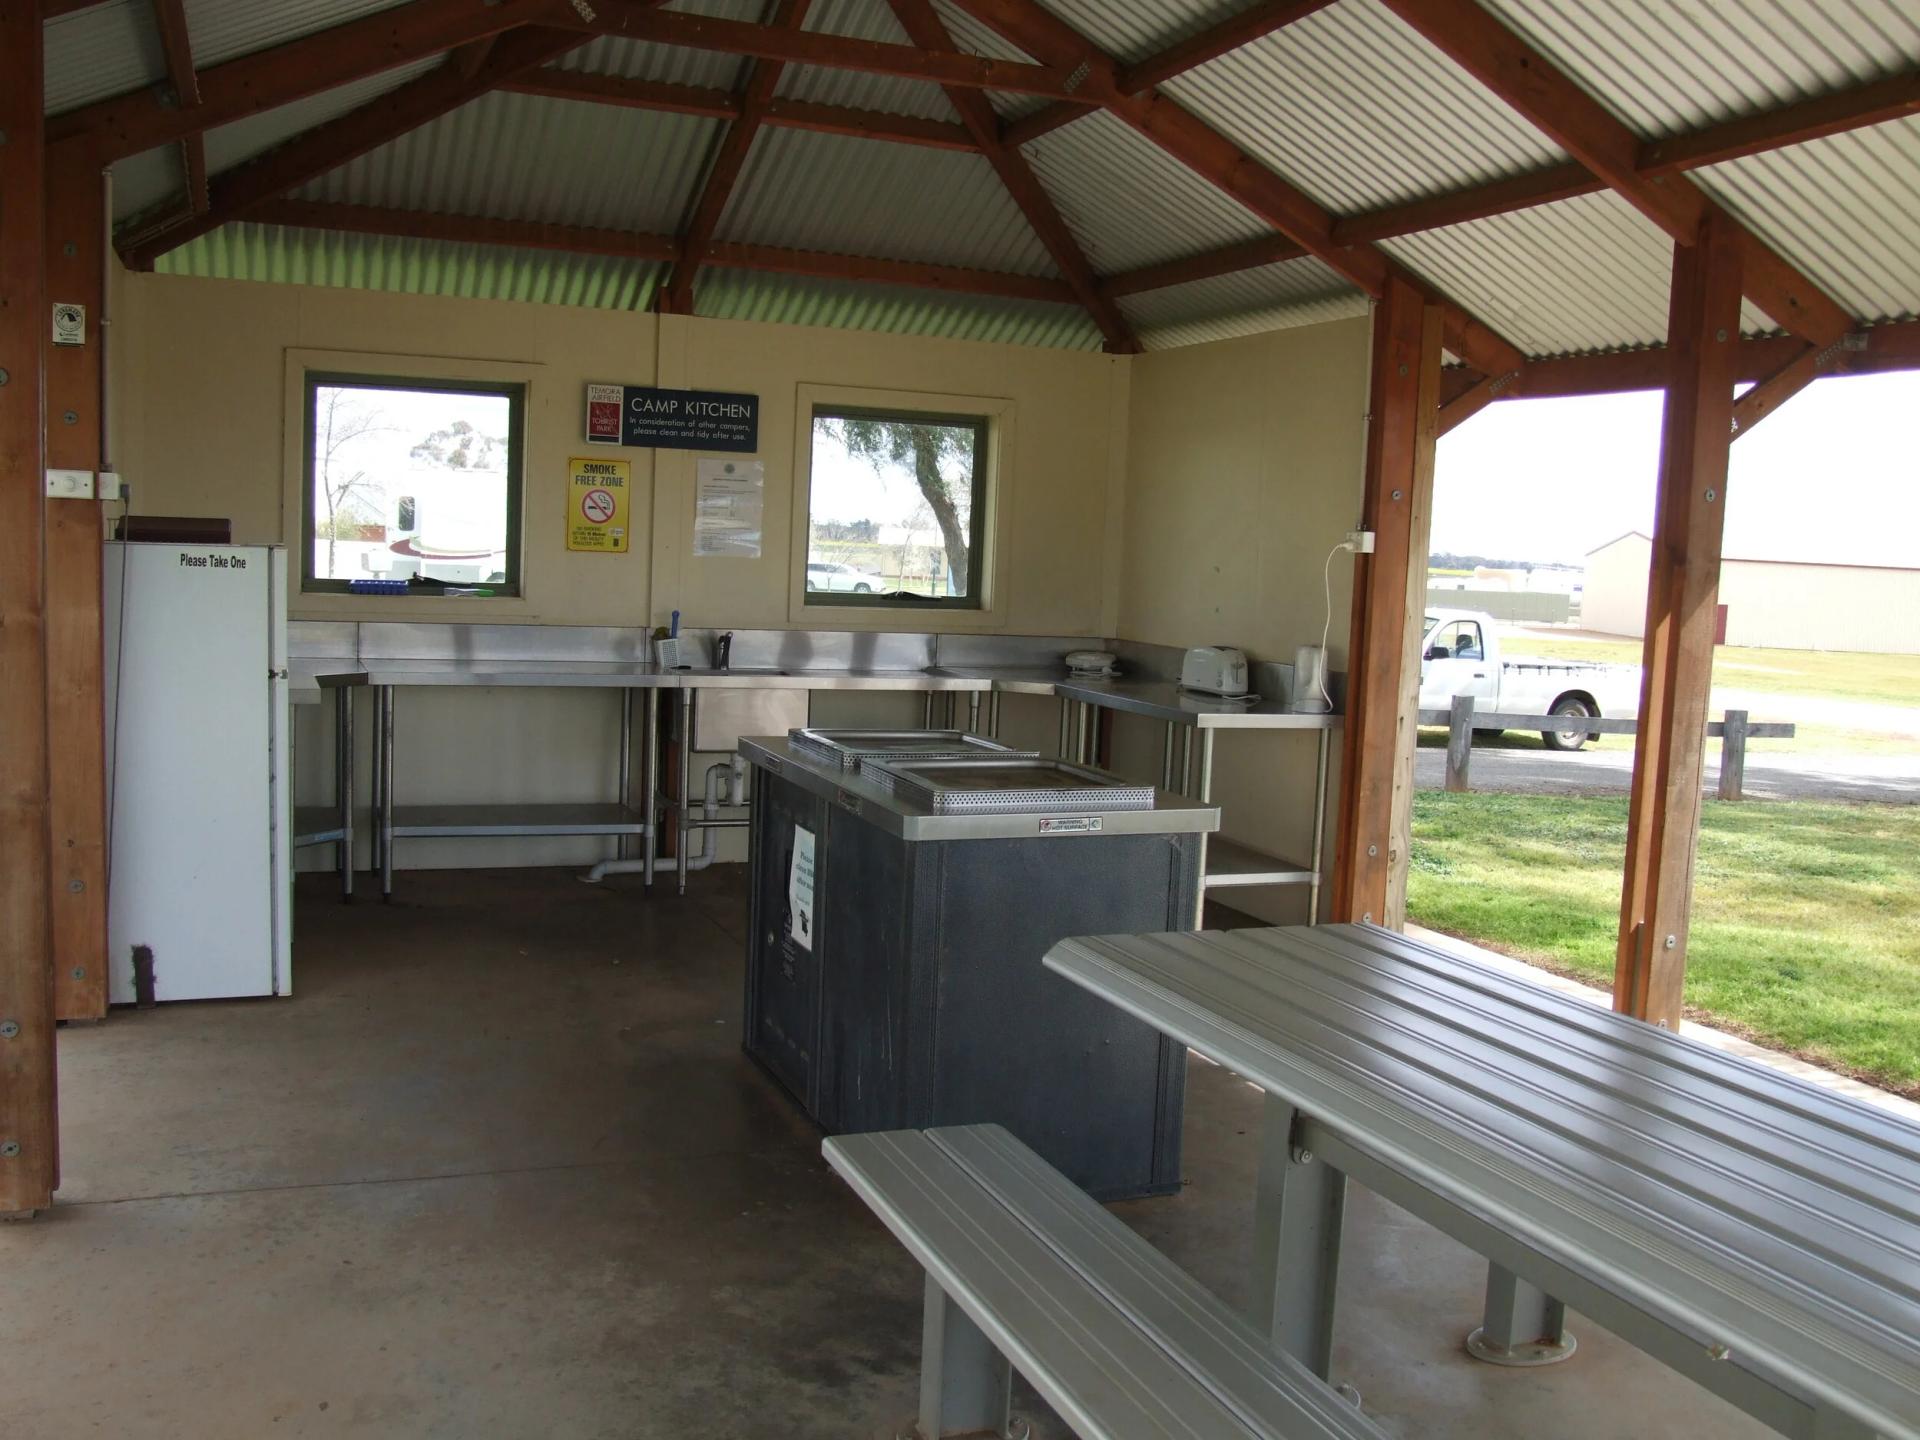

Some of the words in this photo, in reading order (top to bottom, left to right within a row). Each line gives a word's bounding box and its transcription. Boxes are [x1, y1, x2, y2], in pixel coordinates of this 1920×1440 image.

[631, 397, 678, 413] CAMP
[685, 401, 751, 418] KITCHEN
[629, 416, 637, 424] In
[638, 417, 686, 427] consideration
[688, 420, 696, 428] of
[698, 421, 717, 429] other
[719, 424, 751, 432] campers,
[633, 426, 657, 435] please
[659, 427, 679, 436] clean
[680, 429, 695, 438] and
[697, 430, 710, 439] tidy
[712, 432, 730, 440] after
[583, 463, 617, 475] SMOKE
[575, 475, 597, 486] FREE
[600, 476, 624, 487] ZONE
[180, 553, 207, 567] Please
[209, 554, 229, 568] Take
[230, 555, 247, 569] One
